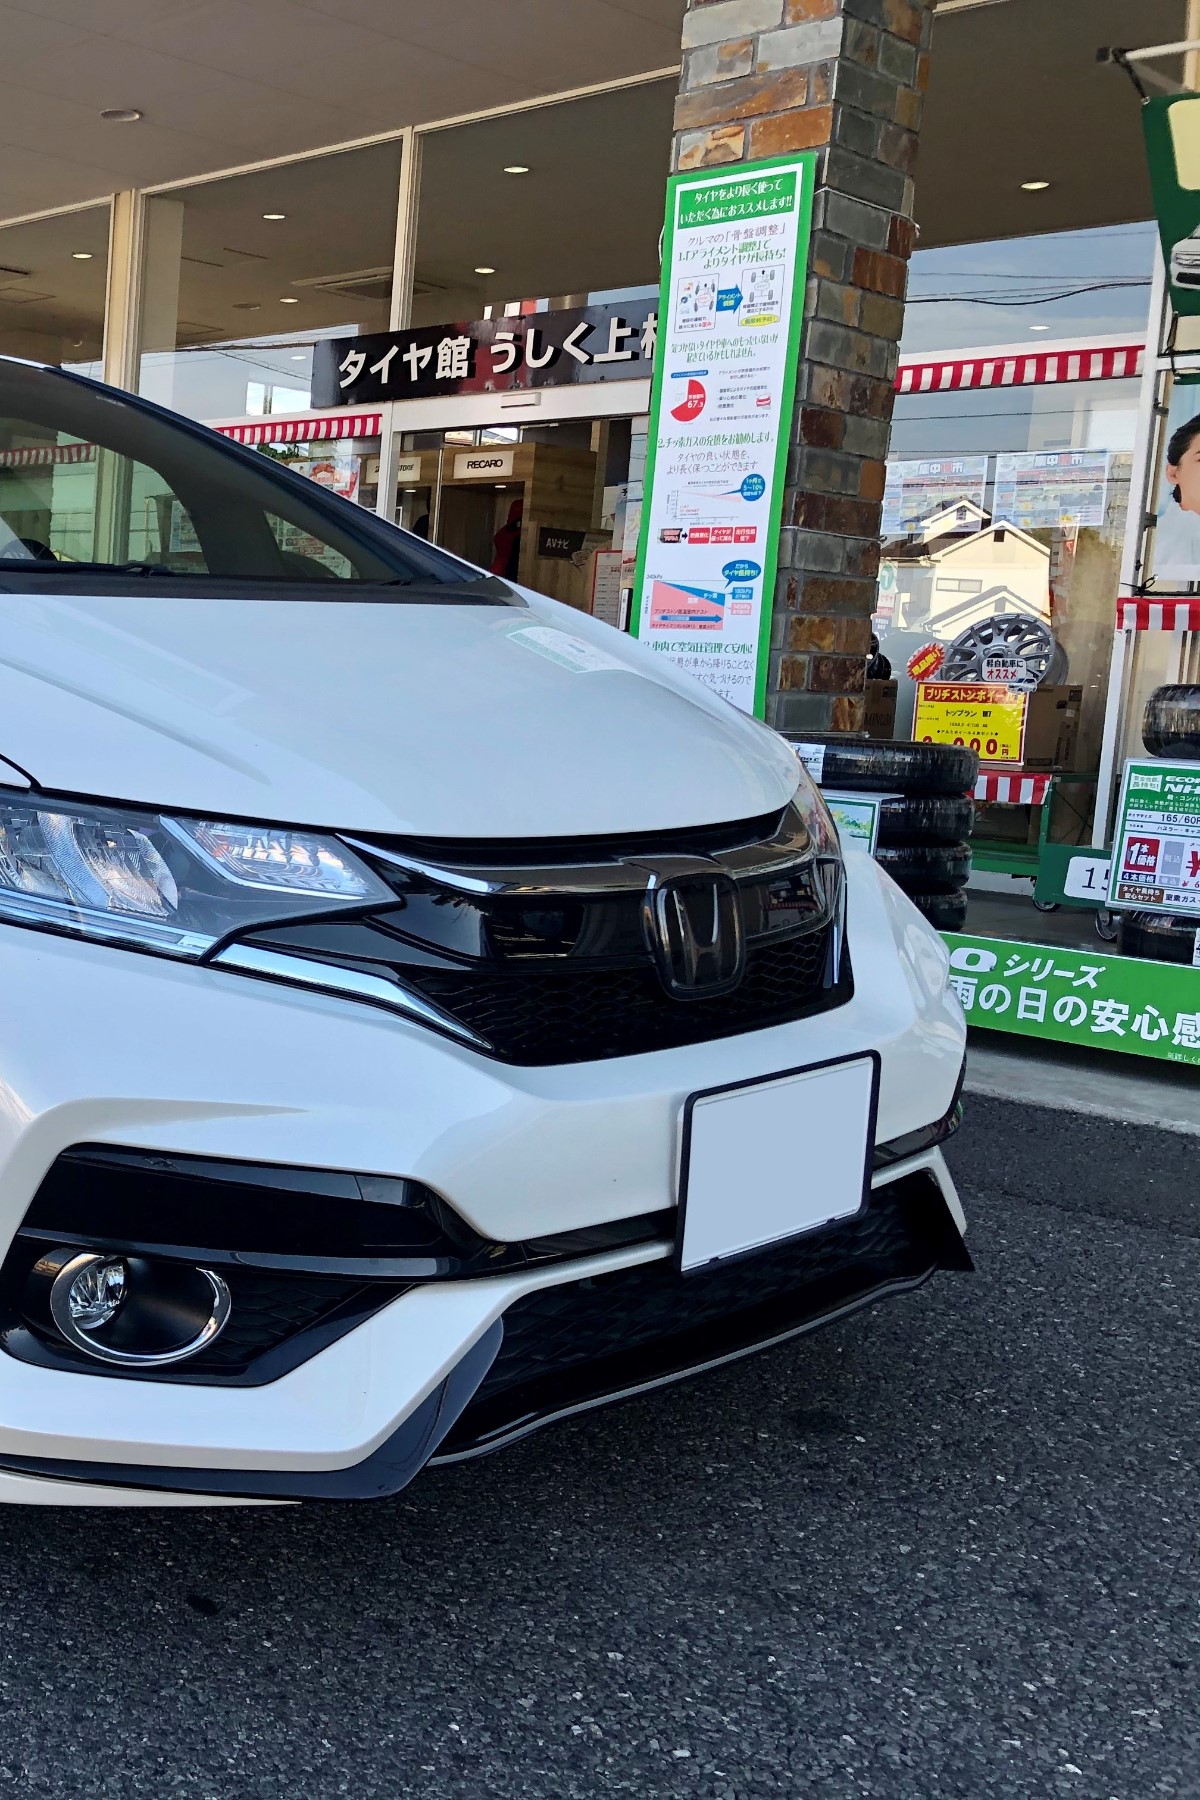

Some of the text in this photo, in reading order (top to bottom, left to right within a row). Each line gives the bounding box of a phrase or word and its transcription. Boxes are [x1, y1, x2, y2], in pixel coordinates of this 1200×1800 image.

[694, 179, 783, 204] タイヤをより長く使って
[339, 334, 471, 388] タイヤ館
[467, 458, 503, 469] RECARO
[986, 659, 1024, 669] 軽自動車に
[987, 669, 1017, 680] オススメ
[1123, 873, 1155, 884] 4本価格
[1003, 953, 1107, 989] シリーズ
[949, 974, 1200, 1049] 雨の日の安心感
